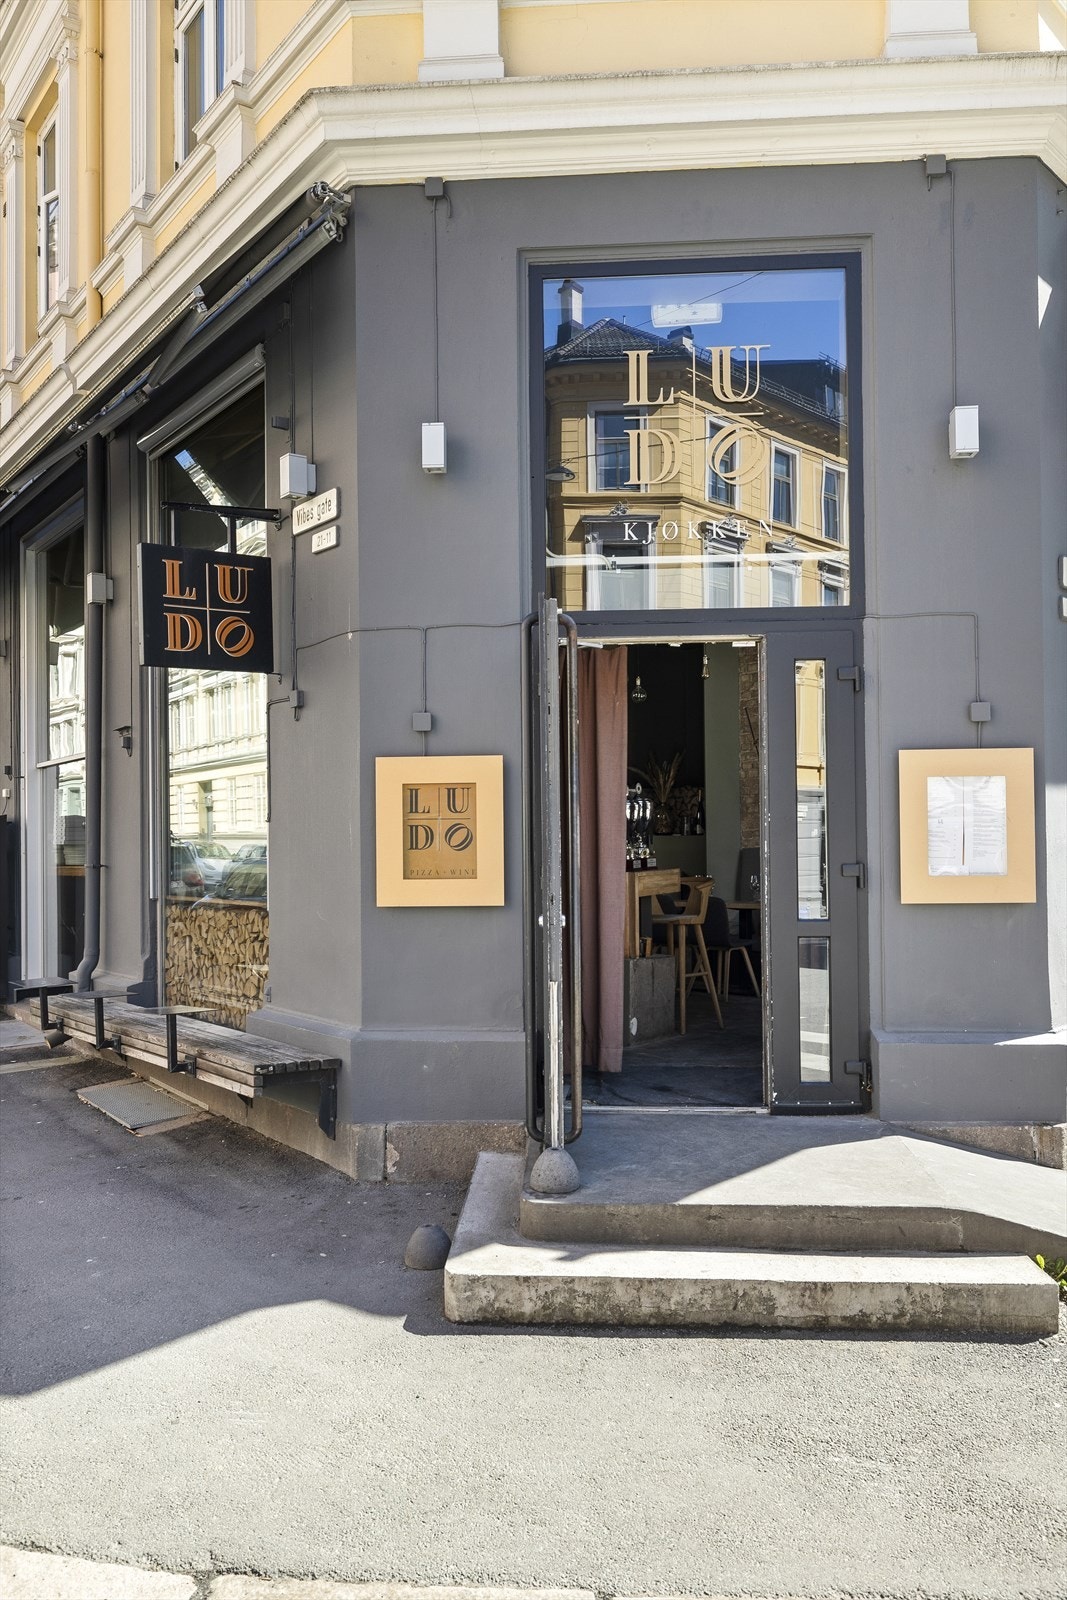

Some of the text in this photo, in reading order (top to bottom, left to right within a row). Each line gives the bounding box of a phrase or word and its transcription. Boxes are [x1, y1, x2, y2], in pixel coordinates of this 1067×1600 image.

[296, 497, 332, 526] Vibes gate
[623, 518, 774, 545] KJØKKEN
